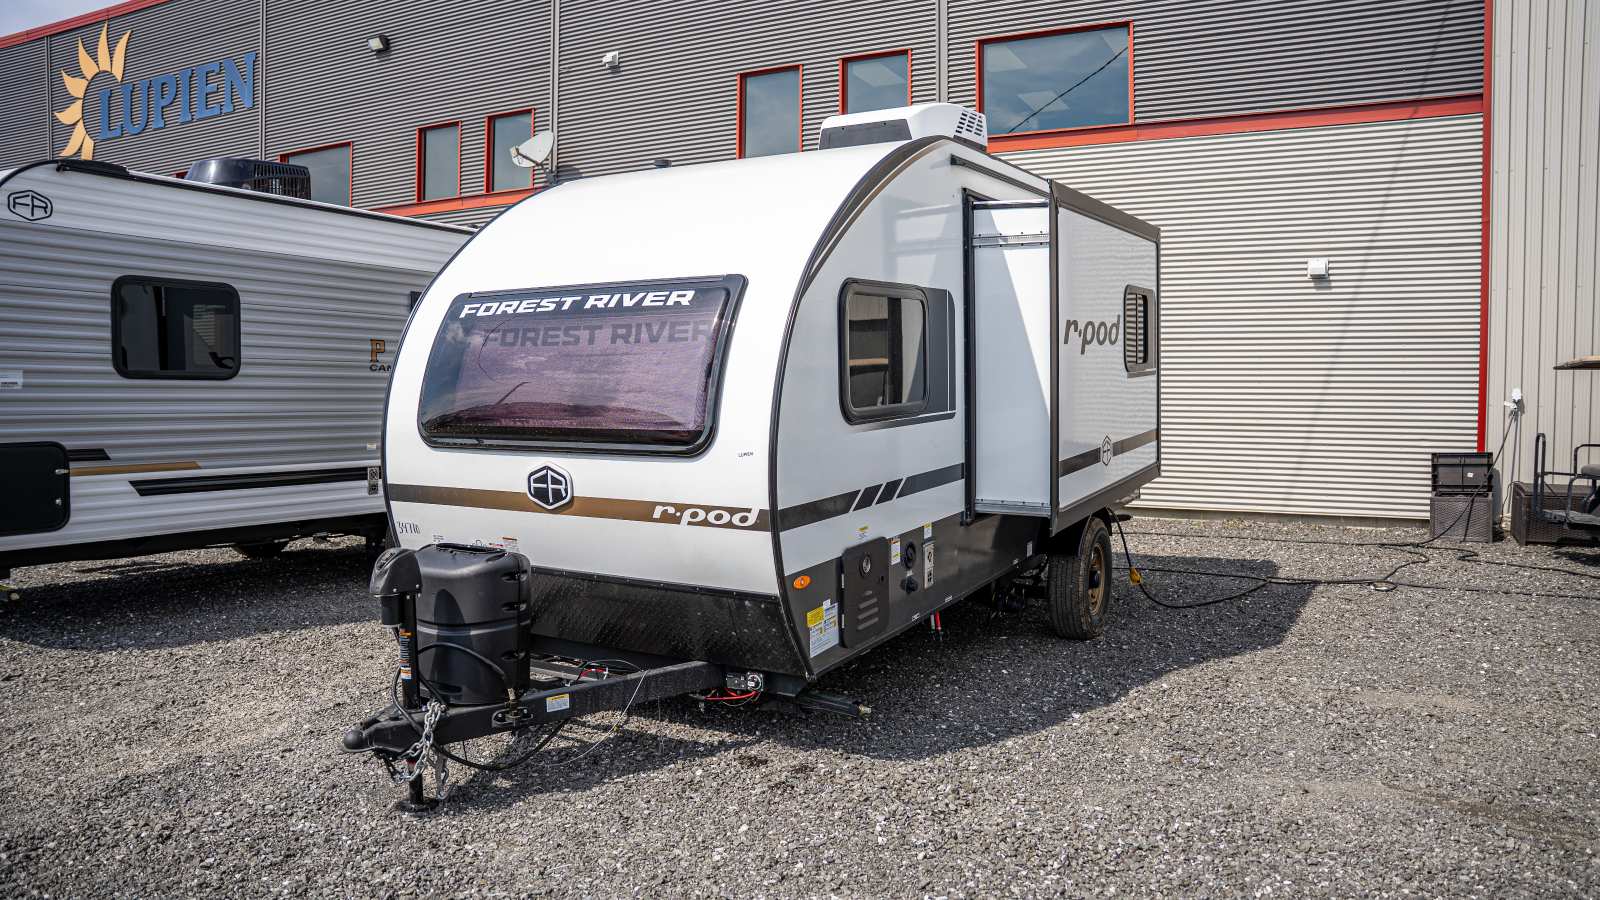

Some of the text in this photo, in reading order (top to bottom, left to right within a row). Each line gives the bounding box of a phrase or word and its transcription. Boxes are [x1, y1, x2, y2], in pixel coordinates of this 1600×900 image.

[97, 51, 257, 141] LUPIEN
[459, 289, 696, 319] FOREST RIVER
